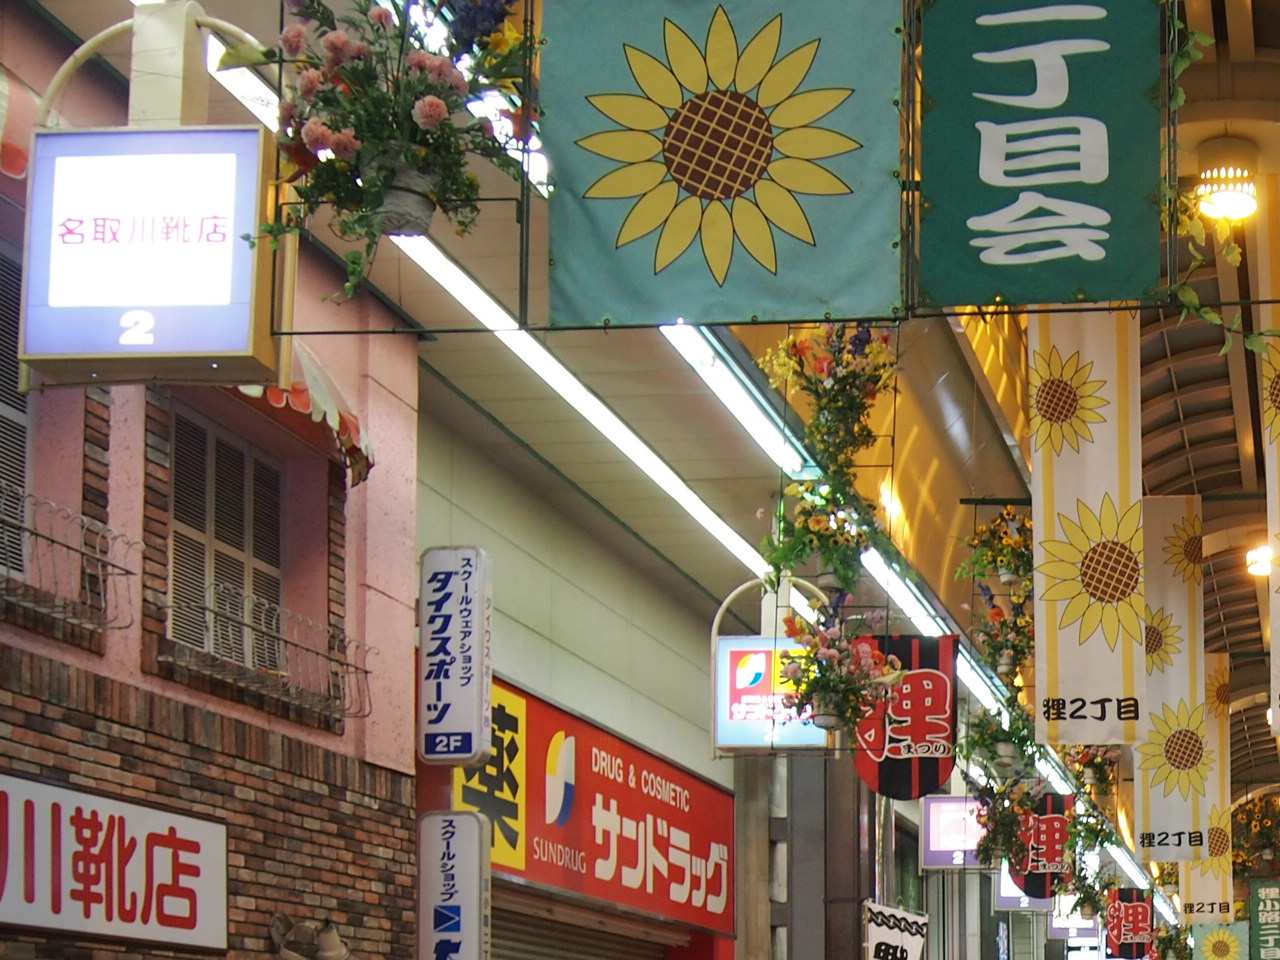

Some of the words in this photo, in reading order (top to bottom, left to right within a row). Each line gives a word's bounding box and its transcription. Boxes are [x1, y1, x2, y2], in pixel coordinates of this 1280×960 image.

[58, 216, 227, 244] 名取川靴店
[119, 310, 155, 345] 2
[459, 557, 473, 687] スクールウェアショップ
[1043, 696, 1140, 721] 狸2丁目
[434, 735, 463, 753] 2F
[902, 743, 946, 756] まつり
[592, 747, 624, 783] DRUG
[628, 764, 637, 788] &
[641, 769, 690, 813] COSMETIC
[533, 837, 587, 874] SUNDRUG
[592, 793, 728, 914] サンドラッグ
[1139, 830, 1205, 849] 狸2丁目
[0, 790, 201, 930] 川靴店
[440, 819, 458, 902] スクールショップ
[952, 850, 964, 865] 2
